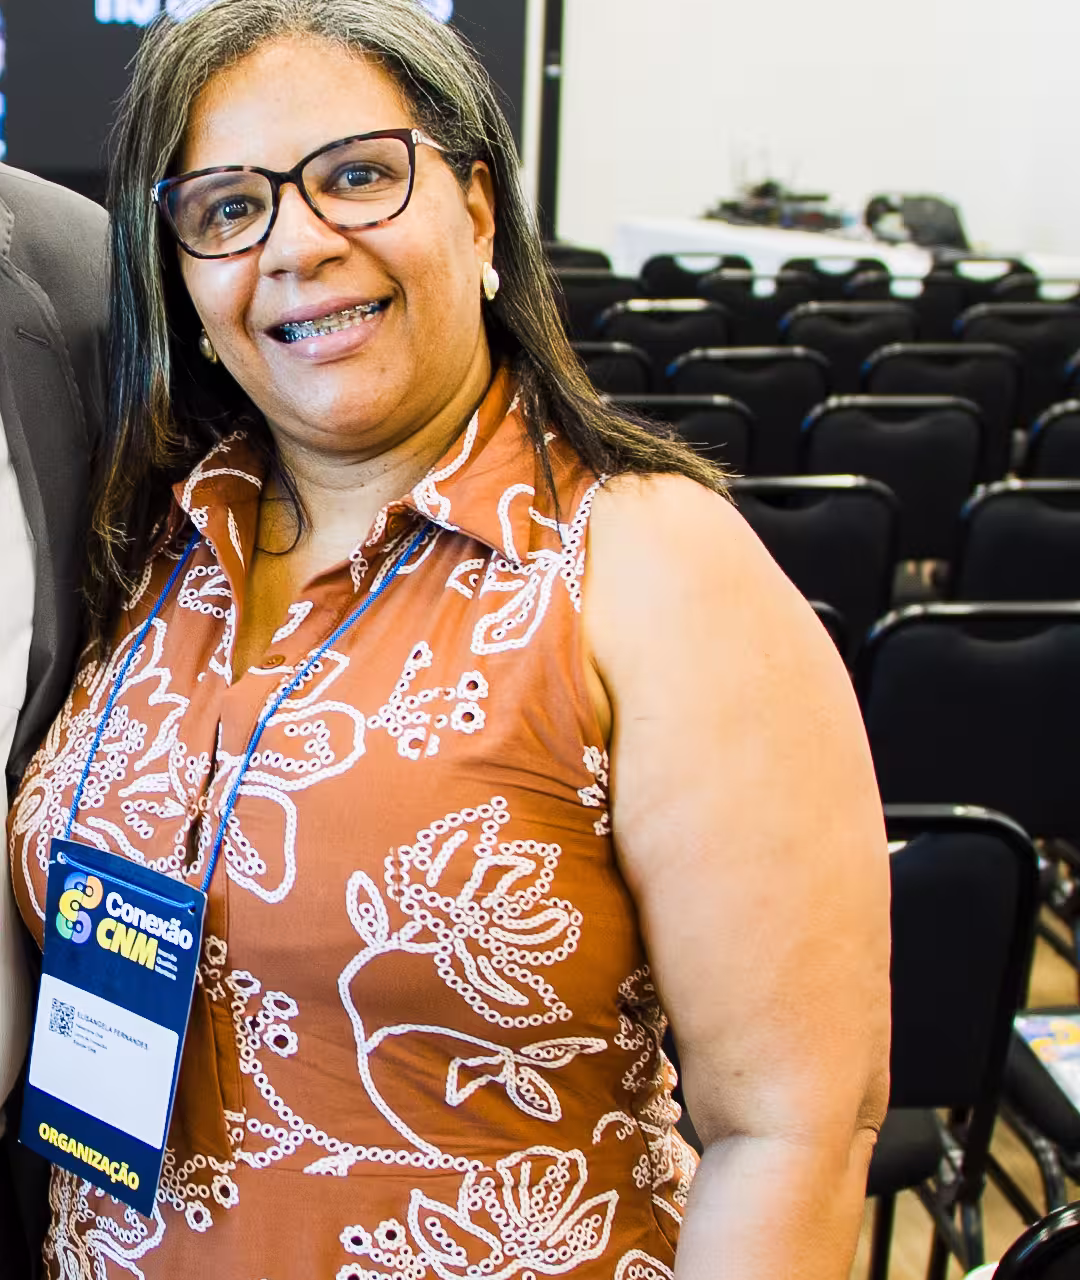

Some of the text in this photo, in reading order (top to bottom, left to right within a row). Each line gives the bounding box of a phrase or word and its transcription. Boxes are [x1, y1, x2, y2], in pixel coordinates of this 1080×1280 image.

[96, 917, 159, 971] CNM
[105, 891, 194, 951] Conexão
[38, 1122, 140, 1191] ORGANIZAÇÃO
